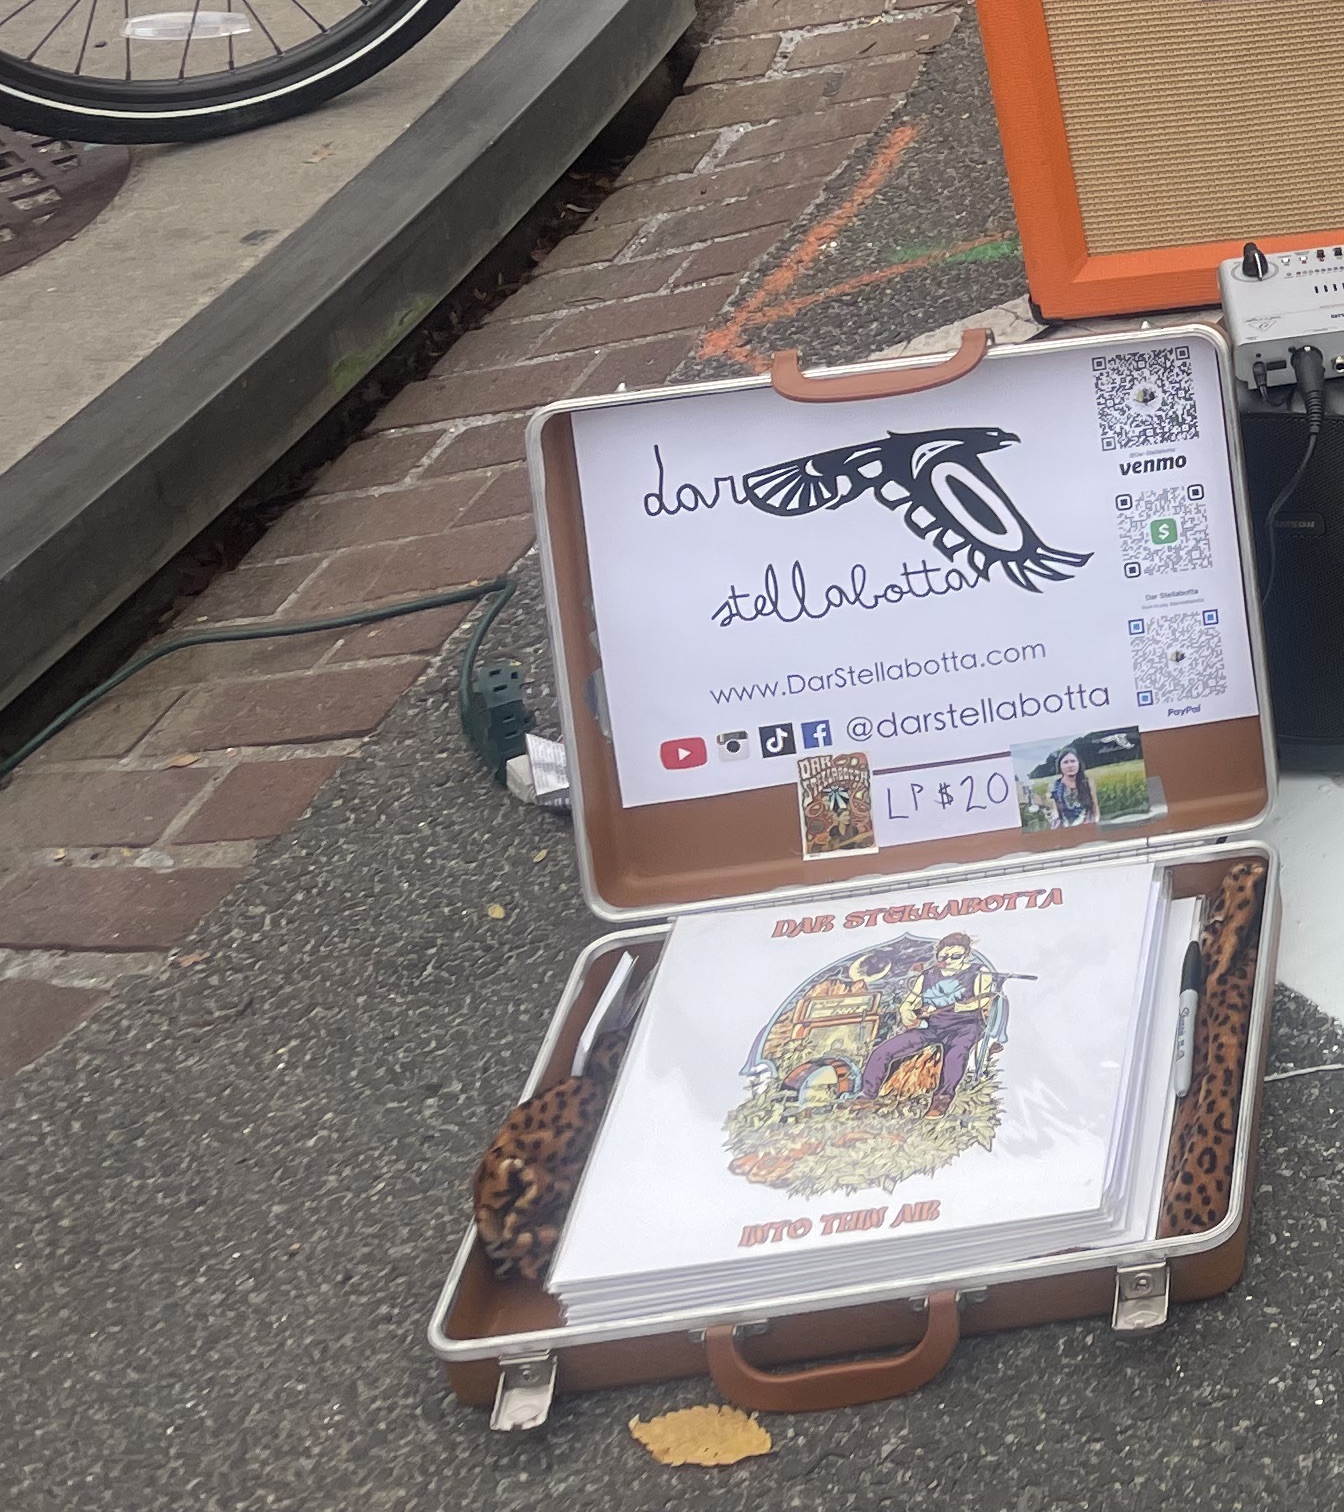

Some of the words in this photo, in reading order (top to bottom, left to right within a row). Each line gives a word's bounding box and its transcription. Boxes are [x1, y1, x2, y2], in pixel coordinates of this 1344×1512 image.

[1119, 455, 1187, 476] venmo
[711, 559, 982, 628] stellabotta
[1145, 593, 1158, 601] Dar
[1160, 588, 1199, 599] Stellabotta
[709, 641, 1047, 705] www.DarStellabotta.com
[846, 684, 1111, 742] @darstellabotta
[1167, 704, 1201, 717] PayPal
[887, 783, 925, 820] LP
[933, 771, 1009, 813] $20
[771, 914, 835, 939] DAR
[843, 888, 1063, 929] STELLABOTTA
[738, 1217, 813, 1248] INTO
[820, 1205, 889, 1236] THIN
[890, 1199, 941, 1229] AIR
